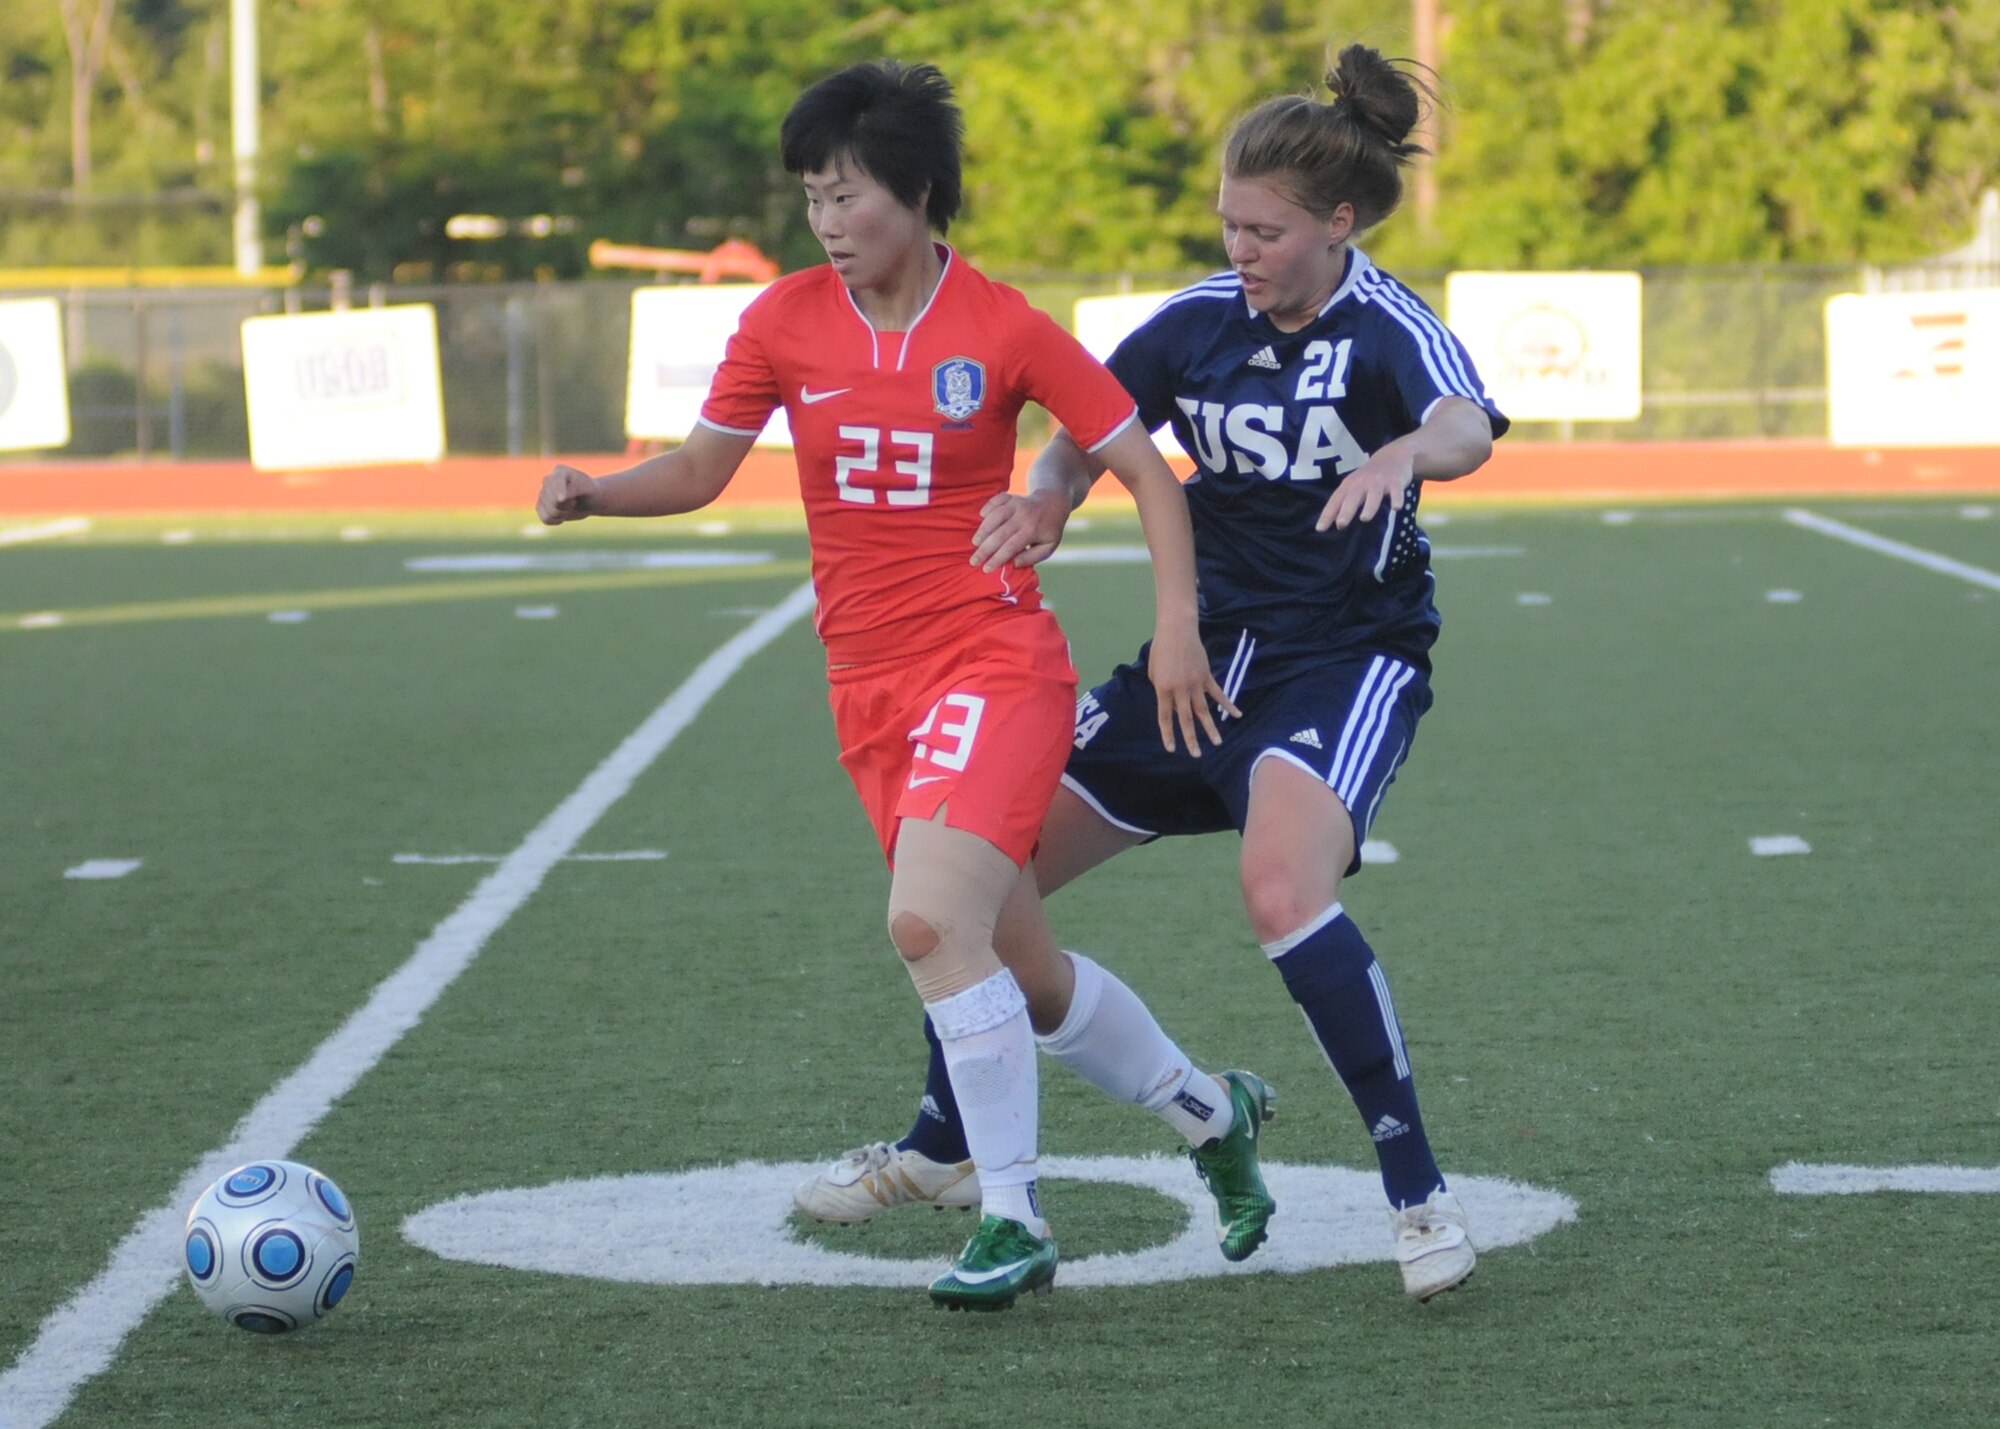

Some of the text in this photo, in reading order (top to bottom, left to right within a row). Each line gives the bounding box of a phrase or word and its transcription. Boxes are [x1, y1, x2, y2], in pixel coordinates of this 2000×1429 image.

[1248, 359, 1281, 370] adidas
[1295, 338, 1353, 401] 21
[836, 425, 934, 505] 23
[1175, 396, 1370, 480] USA
[1289, 735, 1323, 750] adidas
